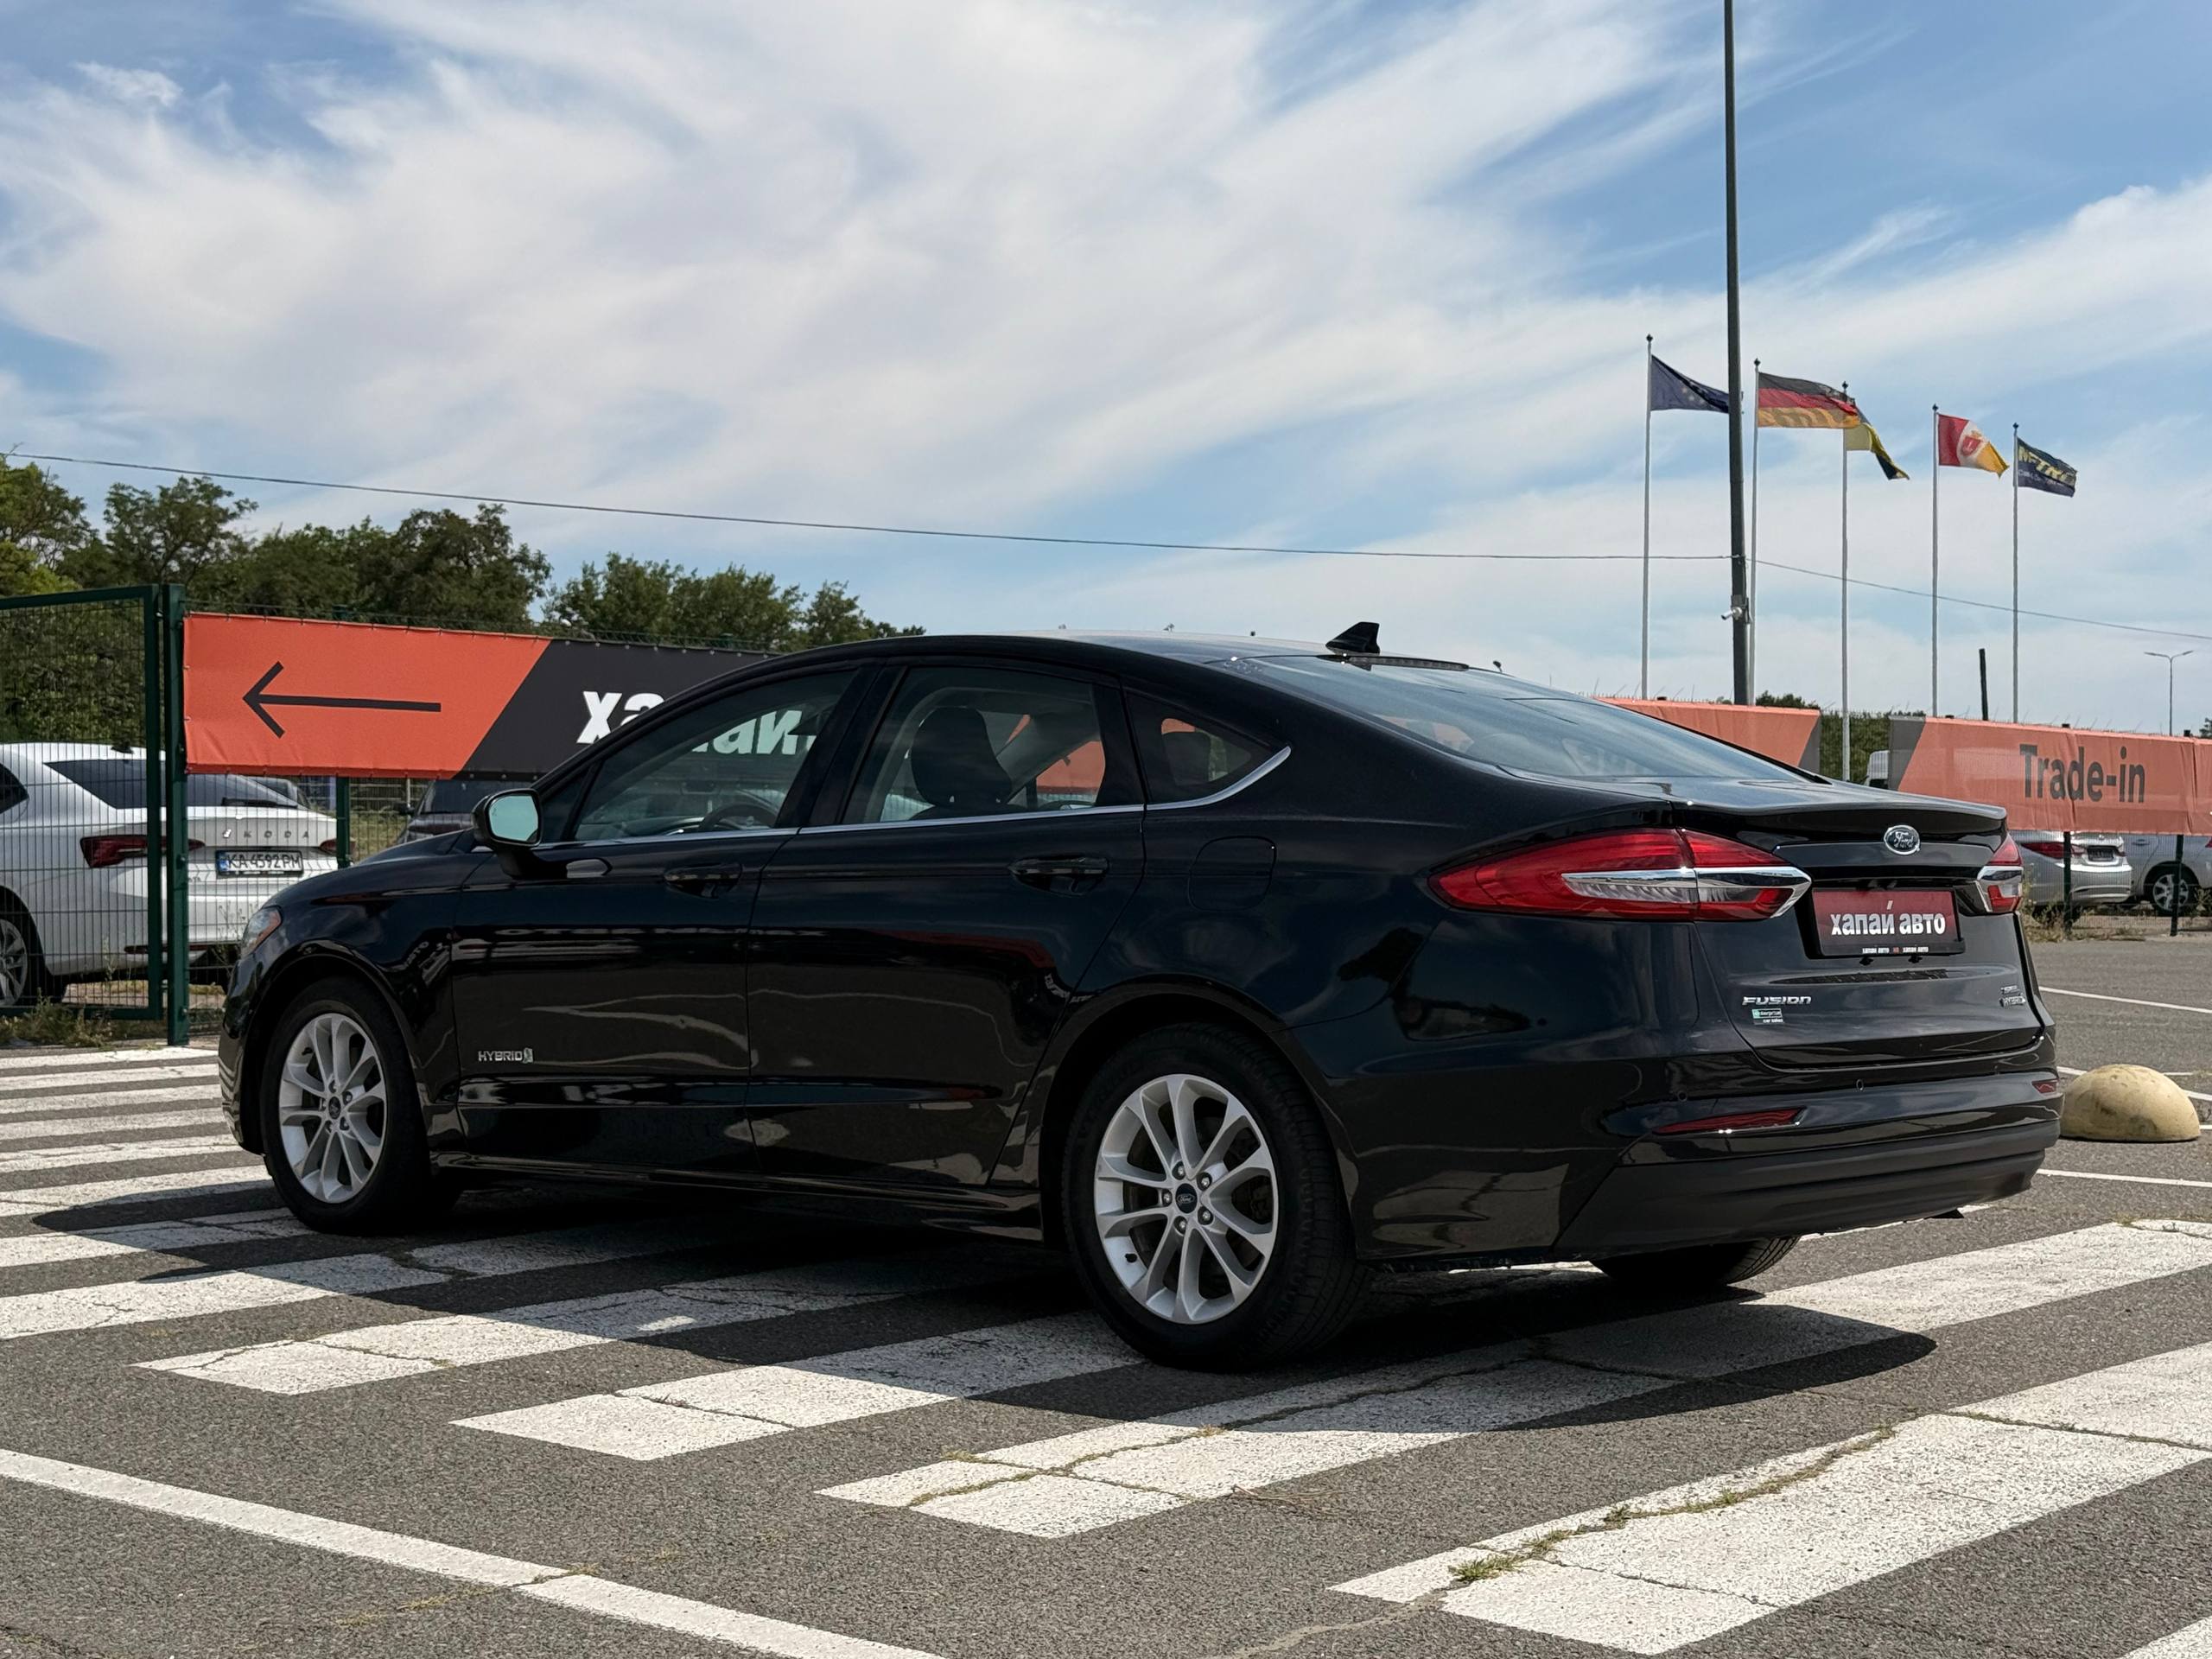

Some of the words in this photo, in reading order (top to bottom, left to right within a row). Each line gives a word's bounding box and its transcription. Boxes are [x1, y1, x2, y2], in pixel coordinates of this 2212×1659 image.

[2019, 744, 2145, 803] Trade-in
[1830, 900, 1895, 935] хапай
[1899, 913, 1946, 934] авто
[1742, 996, 1812, 1005] FUSION
[478, 1051, 523, 1061] HYBRID
